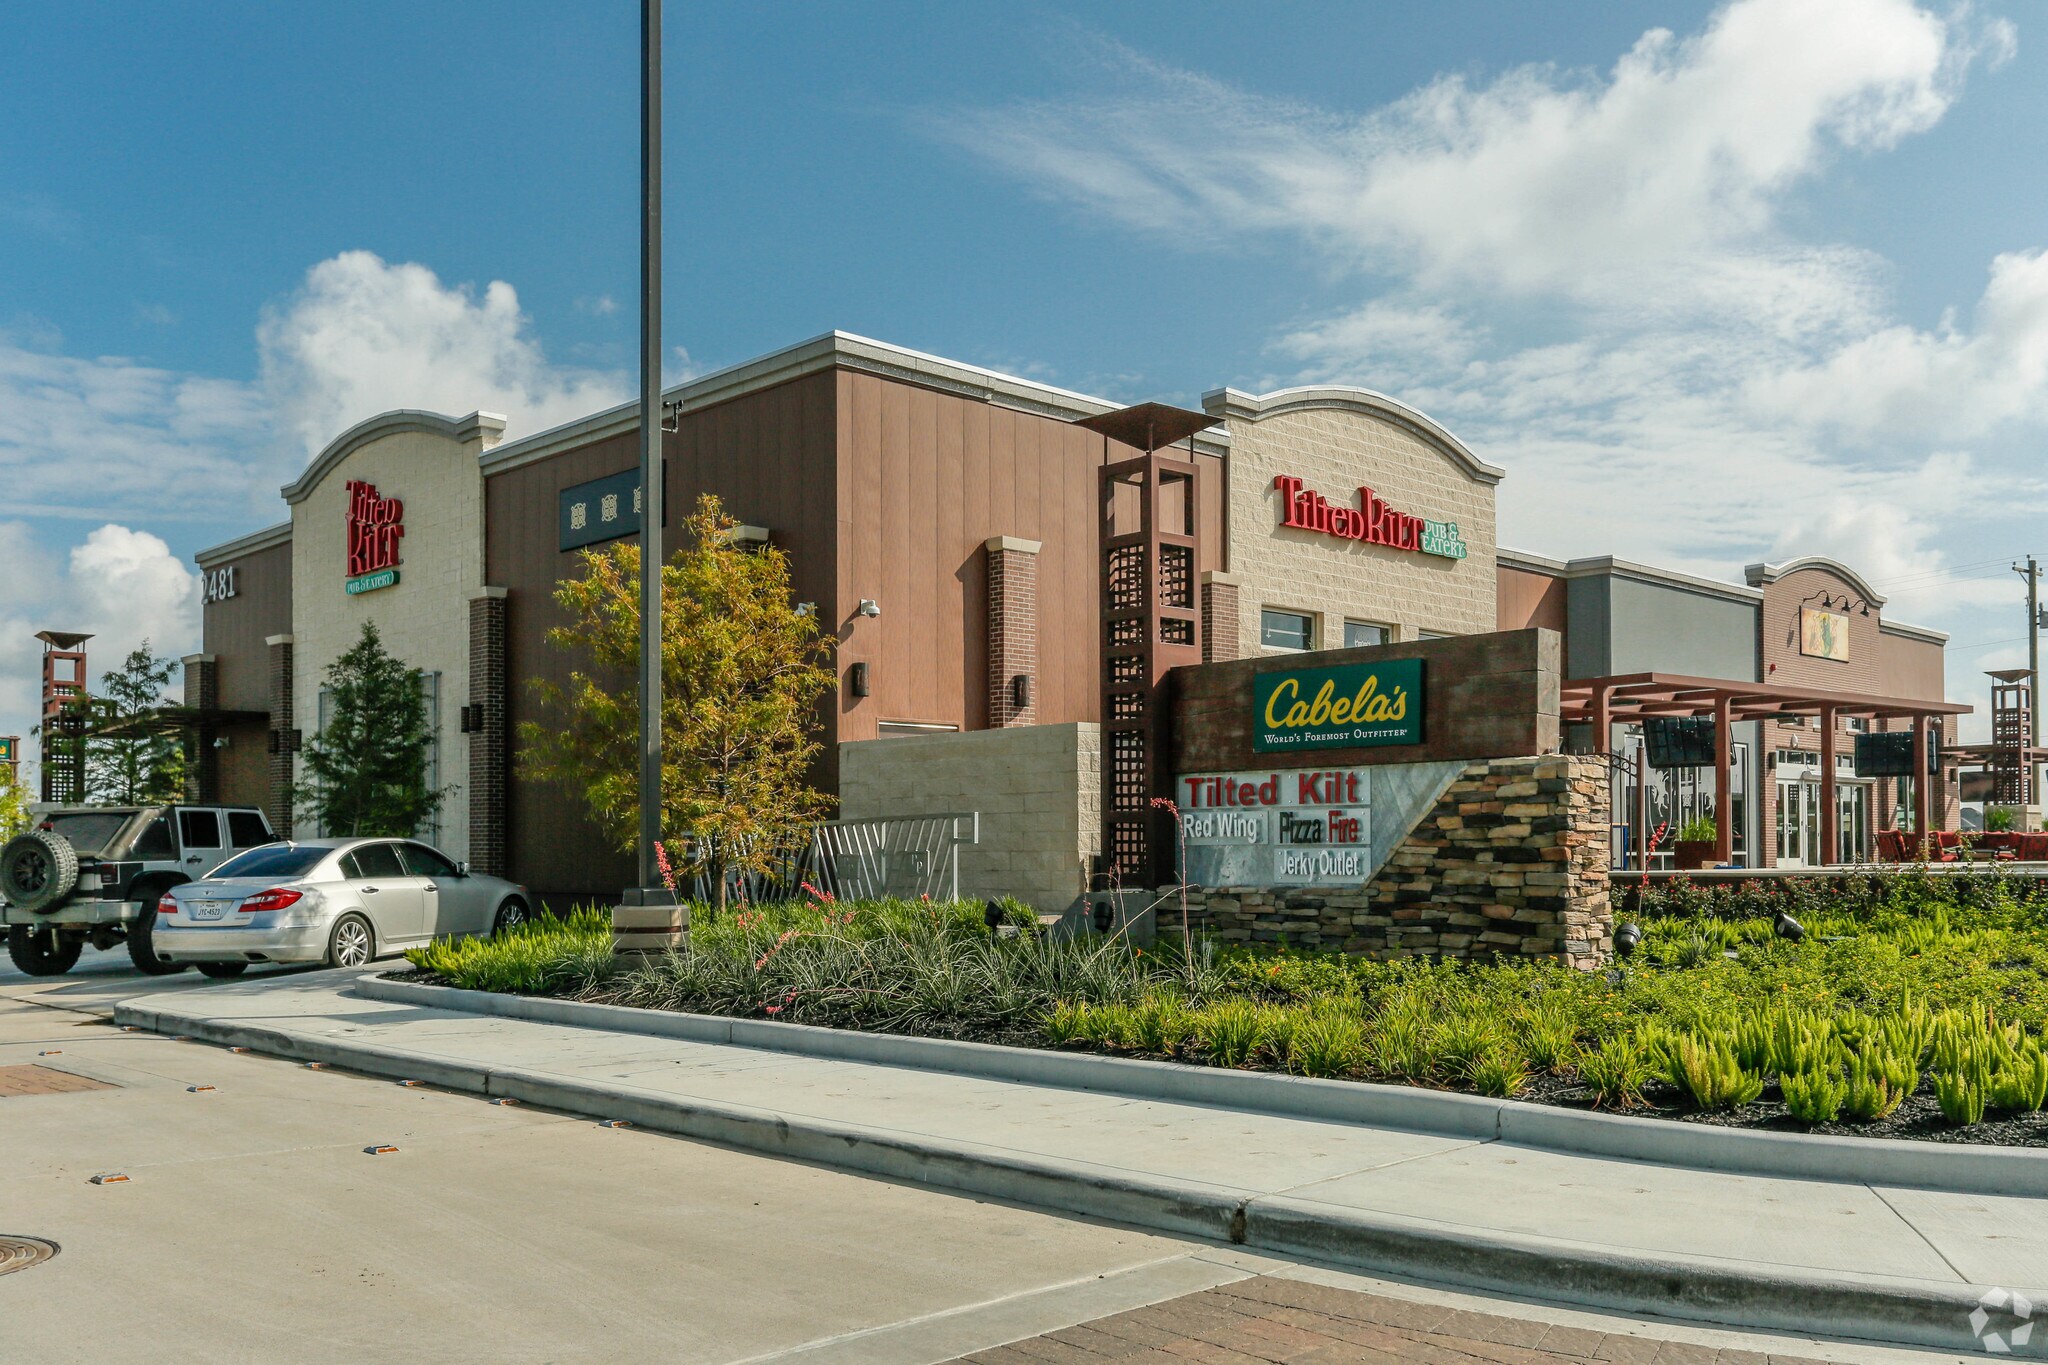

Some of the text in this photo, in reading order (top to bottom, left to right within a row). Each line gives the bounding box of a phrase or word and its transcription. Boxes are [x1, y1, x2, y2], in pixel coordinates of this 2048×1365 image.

[1425, 520, 1458, 541] PUB &
[200, 565, 236, 605] 2481
[1265, 674, 1407, 729] Cabela's
[1304, 731, 1350, 742] FOREMOST
[1184, 771, 1358, 808] Tilted Kilt
[1183, 812, 1257, 844] Red Wing
[1279, 810, 1358, 844] Pizza Fire
[1280, 850, 1359, 883] Jerky Outlet
